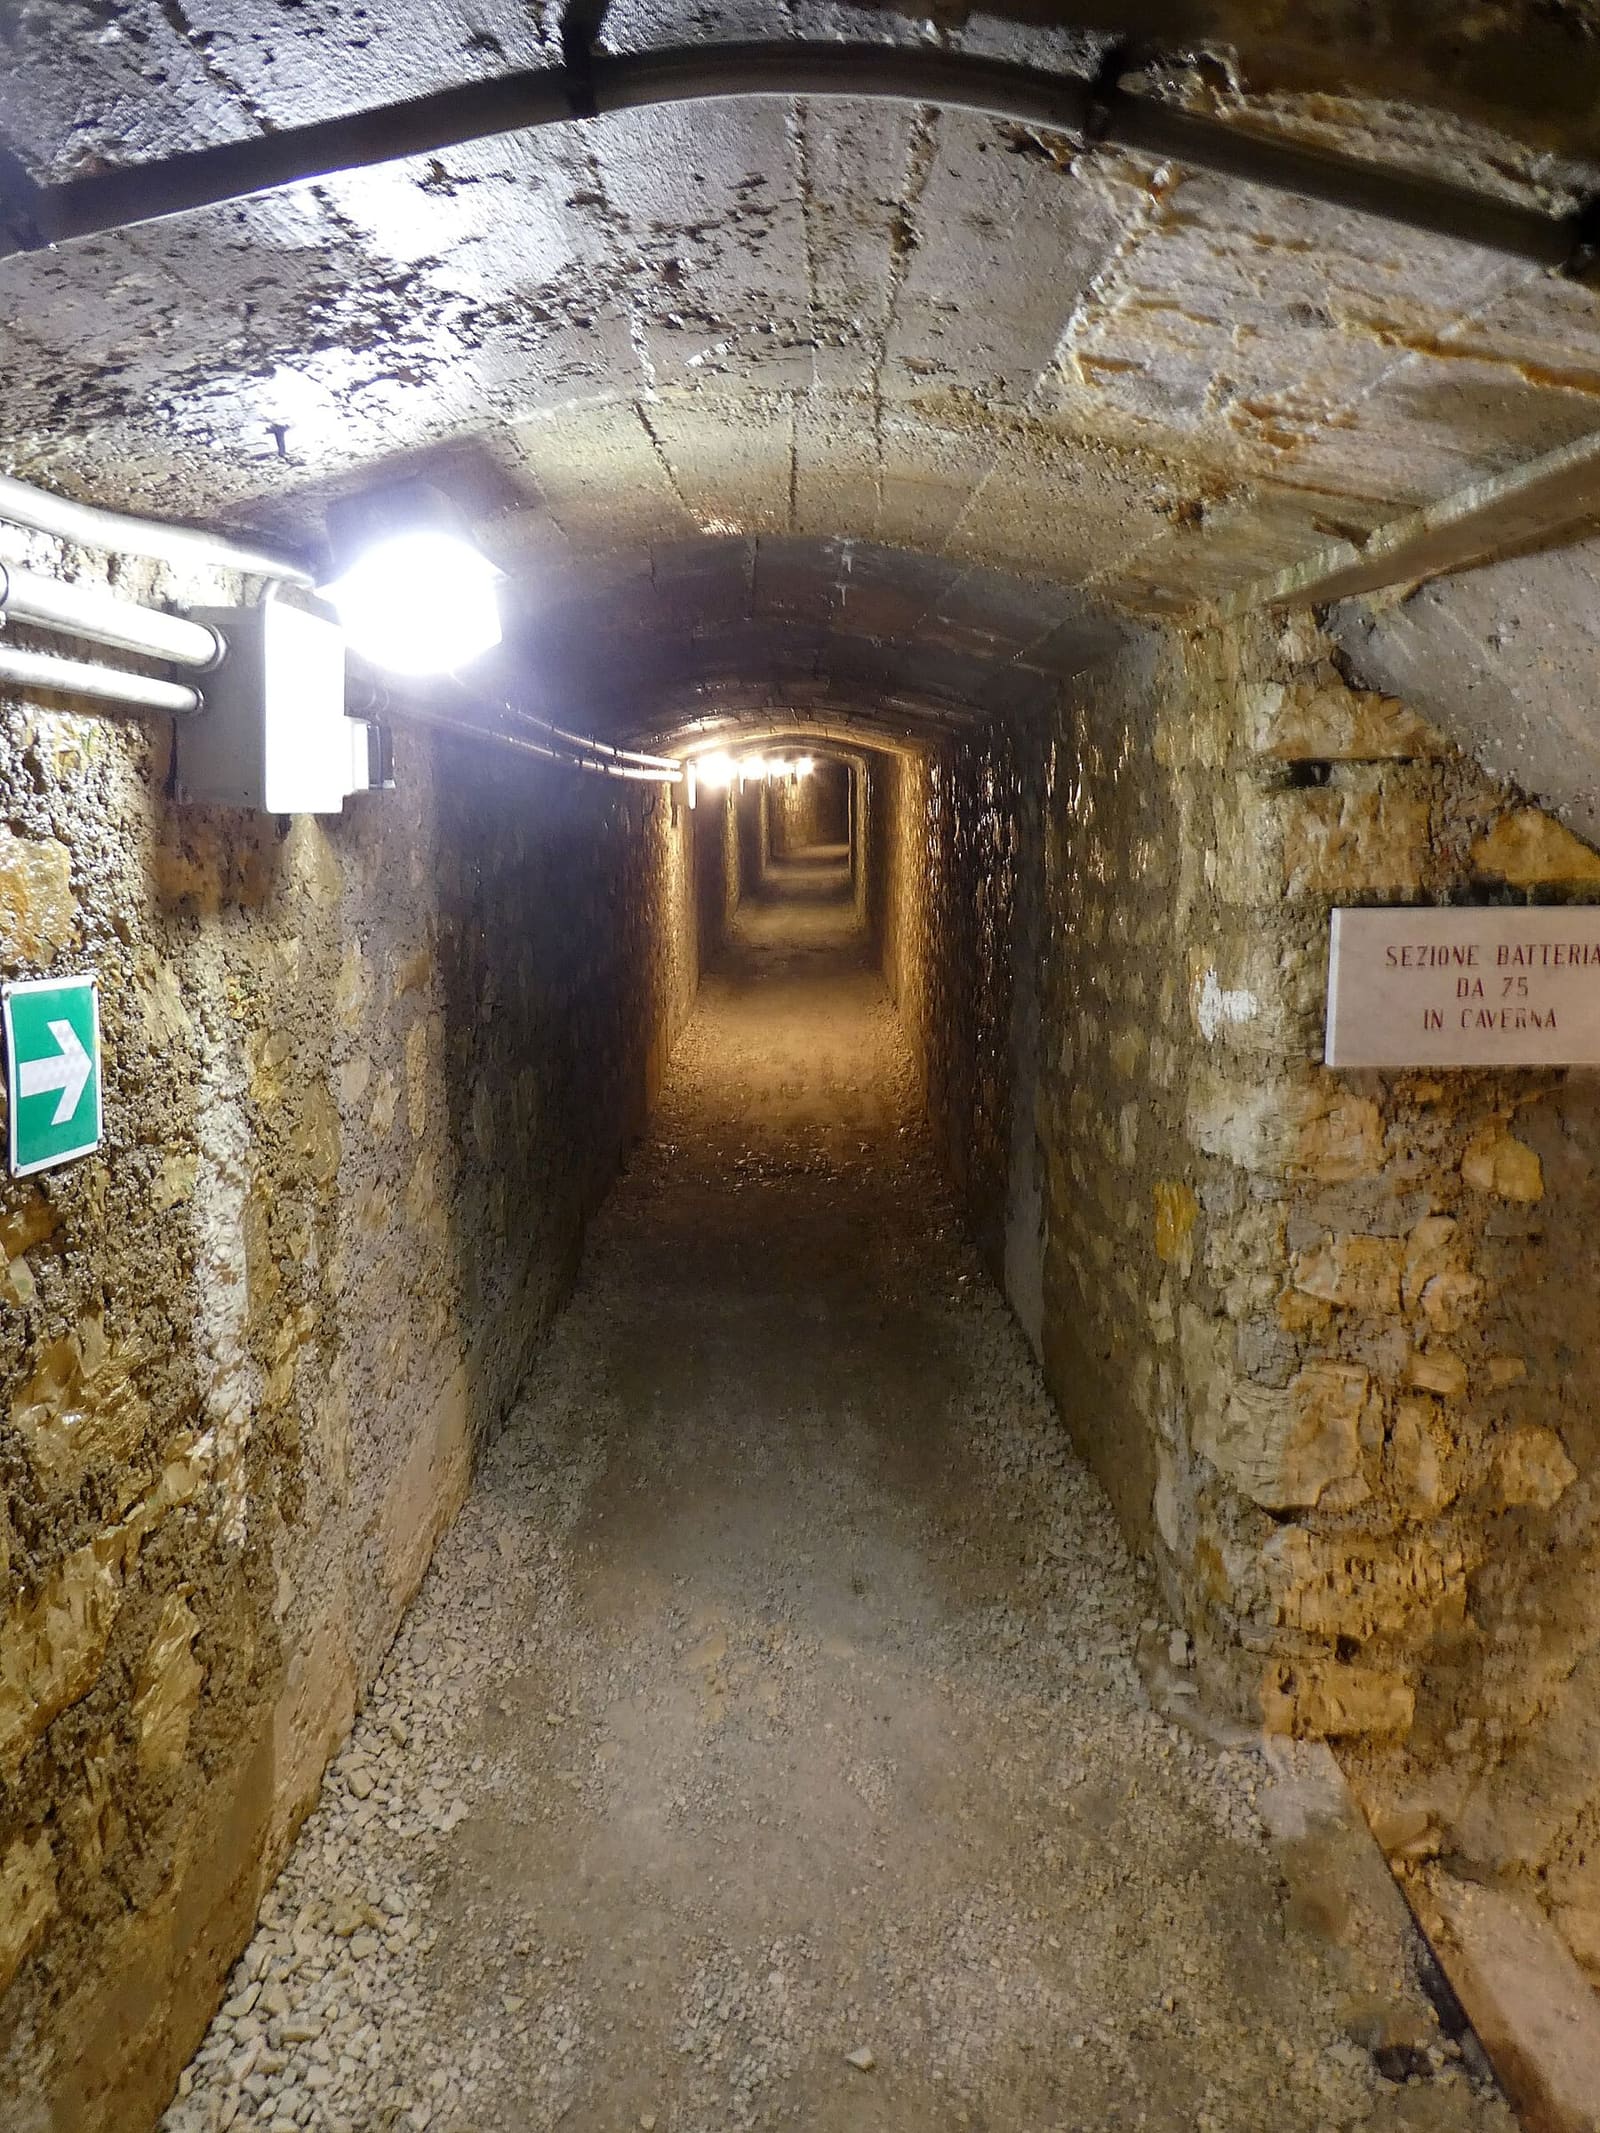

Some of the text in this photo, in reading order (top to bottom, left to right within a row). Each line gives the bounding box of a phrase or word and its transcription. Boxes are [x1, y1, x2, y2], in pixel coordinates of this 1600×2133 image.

[1386, 943, 1600, 967] SEZIONE BATTERIA
[1456, 976, 1529, 998] DA 75
[1423, 1007, 1558, 1030] IN CAVERNA
